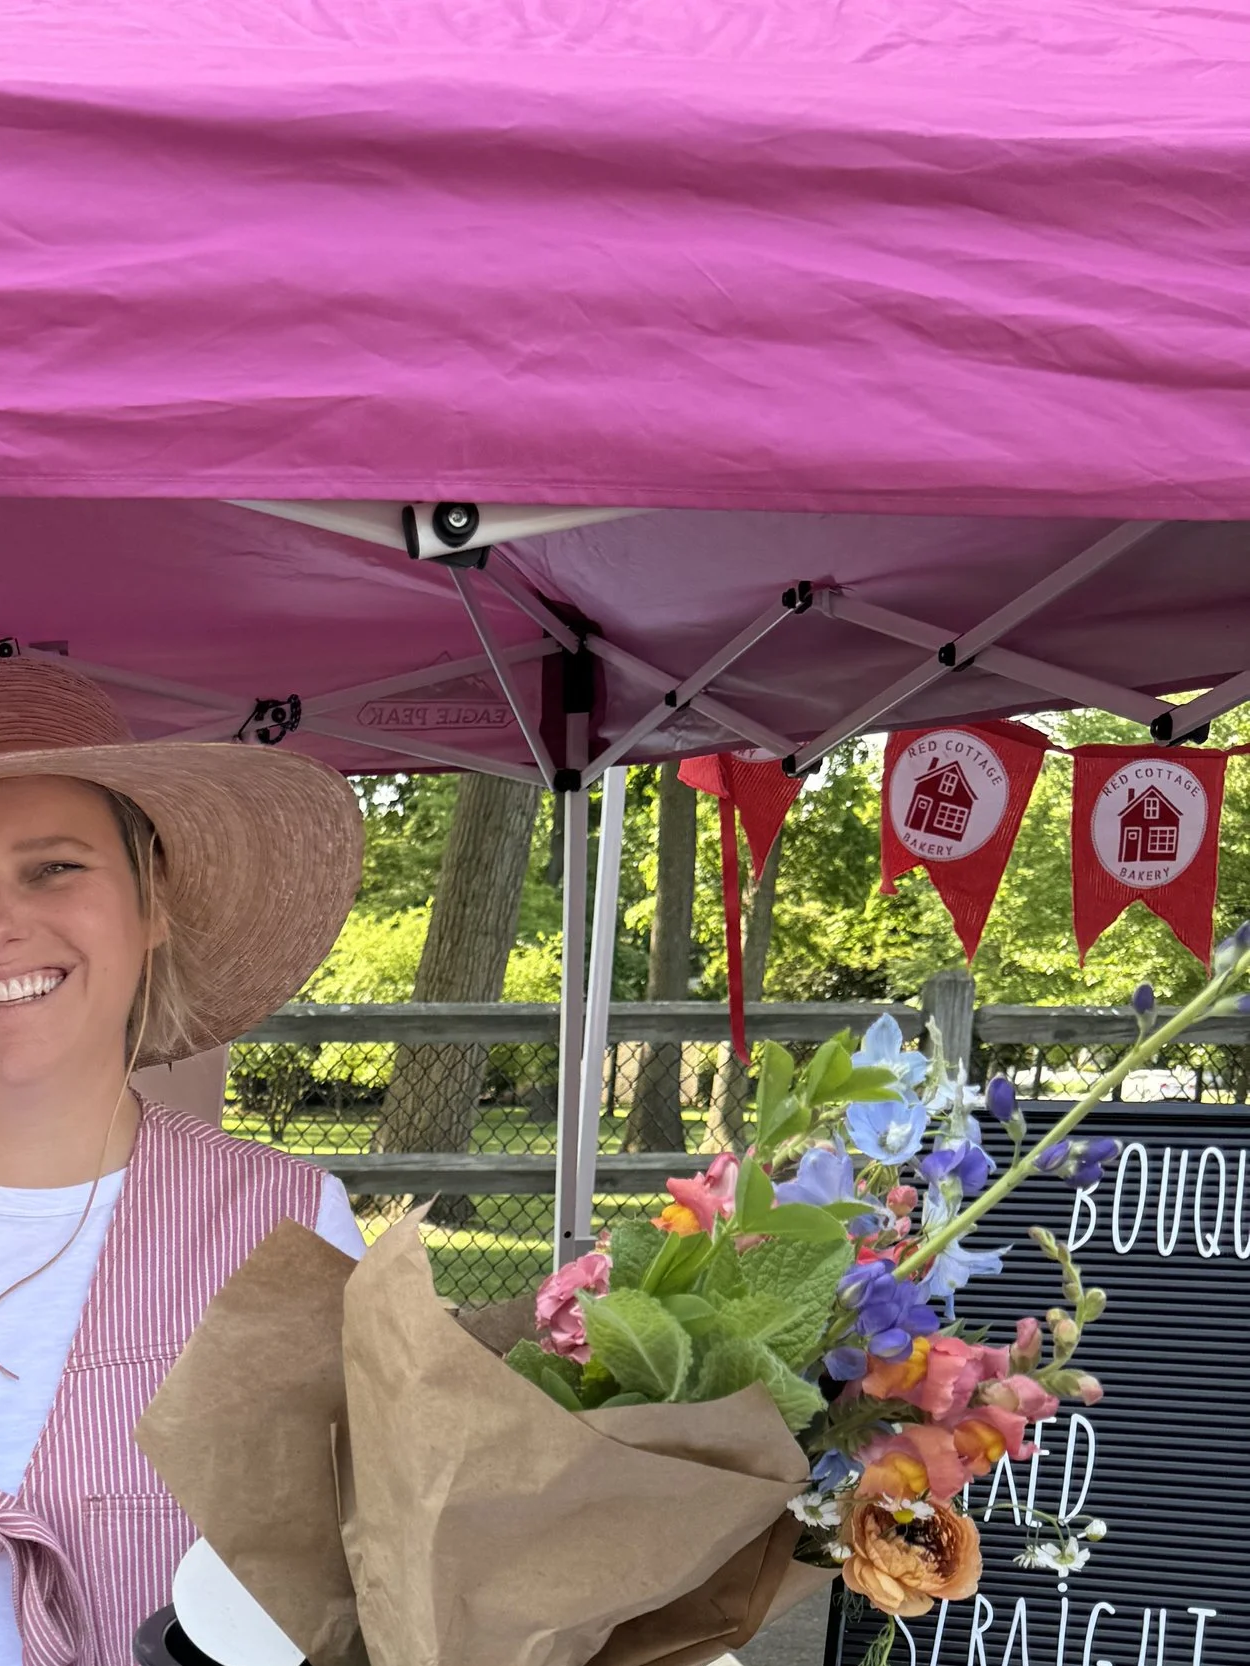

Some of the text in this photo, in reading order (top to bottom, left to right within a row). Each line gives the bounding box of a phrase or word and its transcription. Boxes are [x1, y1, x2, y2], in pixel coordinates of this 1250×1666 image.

[908, 740, 1003, 786] RED COTTAGE
[1102, 768, 1201, 797] RED COTTAGE
[902, 832, 954, 856] BAKERY
[1119, 867, 1170, 882] BAKERY
